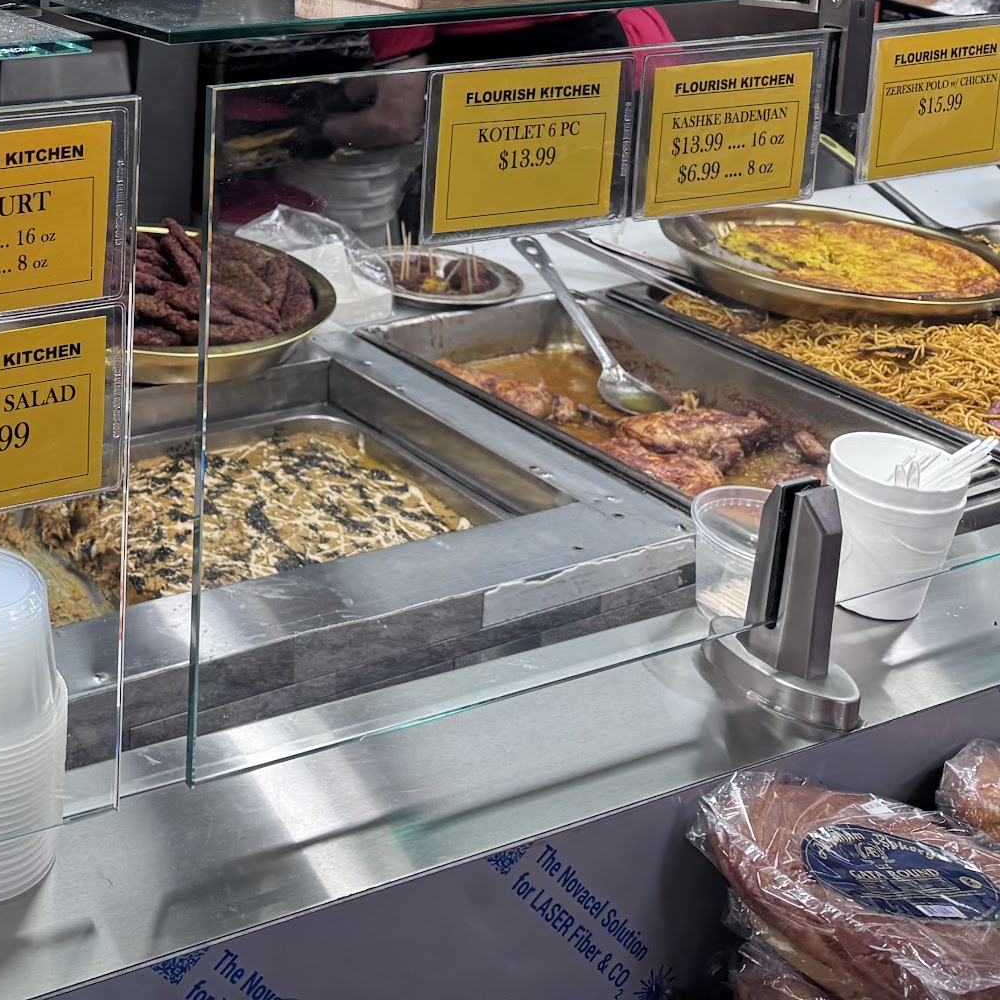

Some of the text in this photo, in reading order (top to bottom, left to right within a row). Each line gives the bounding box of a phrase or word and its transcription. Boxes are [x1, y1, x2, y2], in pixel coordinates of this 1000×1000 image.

[895, 43, 998, 65] FLOURISH KITCHEN
[466, 83, 600, 105] FLOURISH KITCHEN
[675, 73, 795, 95] FLOURISH KITCHEN
[885, 82, 924, 96] ZERESHK
[925, 79, 949, 91] POLO
[960, 73, 998, 87] CHICKEN
[918, 93, 963, 116] $15.99
[672, 107, 788, 130] KASHKE BADEMJAN
[478, 120, 581, 144] KOTLET 6 PC
[5, 144, 84, 166] KITCHEN
[671, 133, 724, 156] $13.99
[751, 132, 766, 148] 16
[769, 133, 785, 146] oz
[498, 146, 557, 171] $13.99
[678, 161, 720, 184] $6.99
[747, 161, 756, 176] 8
[759, 161, 773, 174] oz
[17, 228, 36, 246] 16
[40, 231, 56, 243] oz
[17, 255, 28, 271] 8
[32, 258, 48, 270] oz
[3, 342, 81, 367] KITCHEN
[3, 383, 76, 413] SALAD
[888, 868, 940, 881] ROUND
[537, 843, 649, 962] The Novacel Solution
[511, 872, 535, 900] for
[529, 889, 575, 937] LASER
[567, 924, 602, 963] Fiber
[597, 952, 612, 974] &
[214, 948, 245, 985] The
